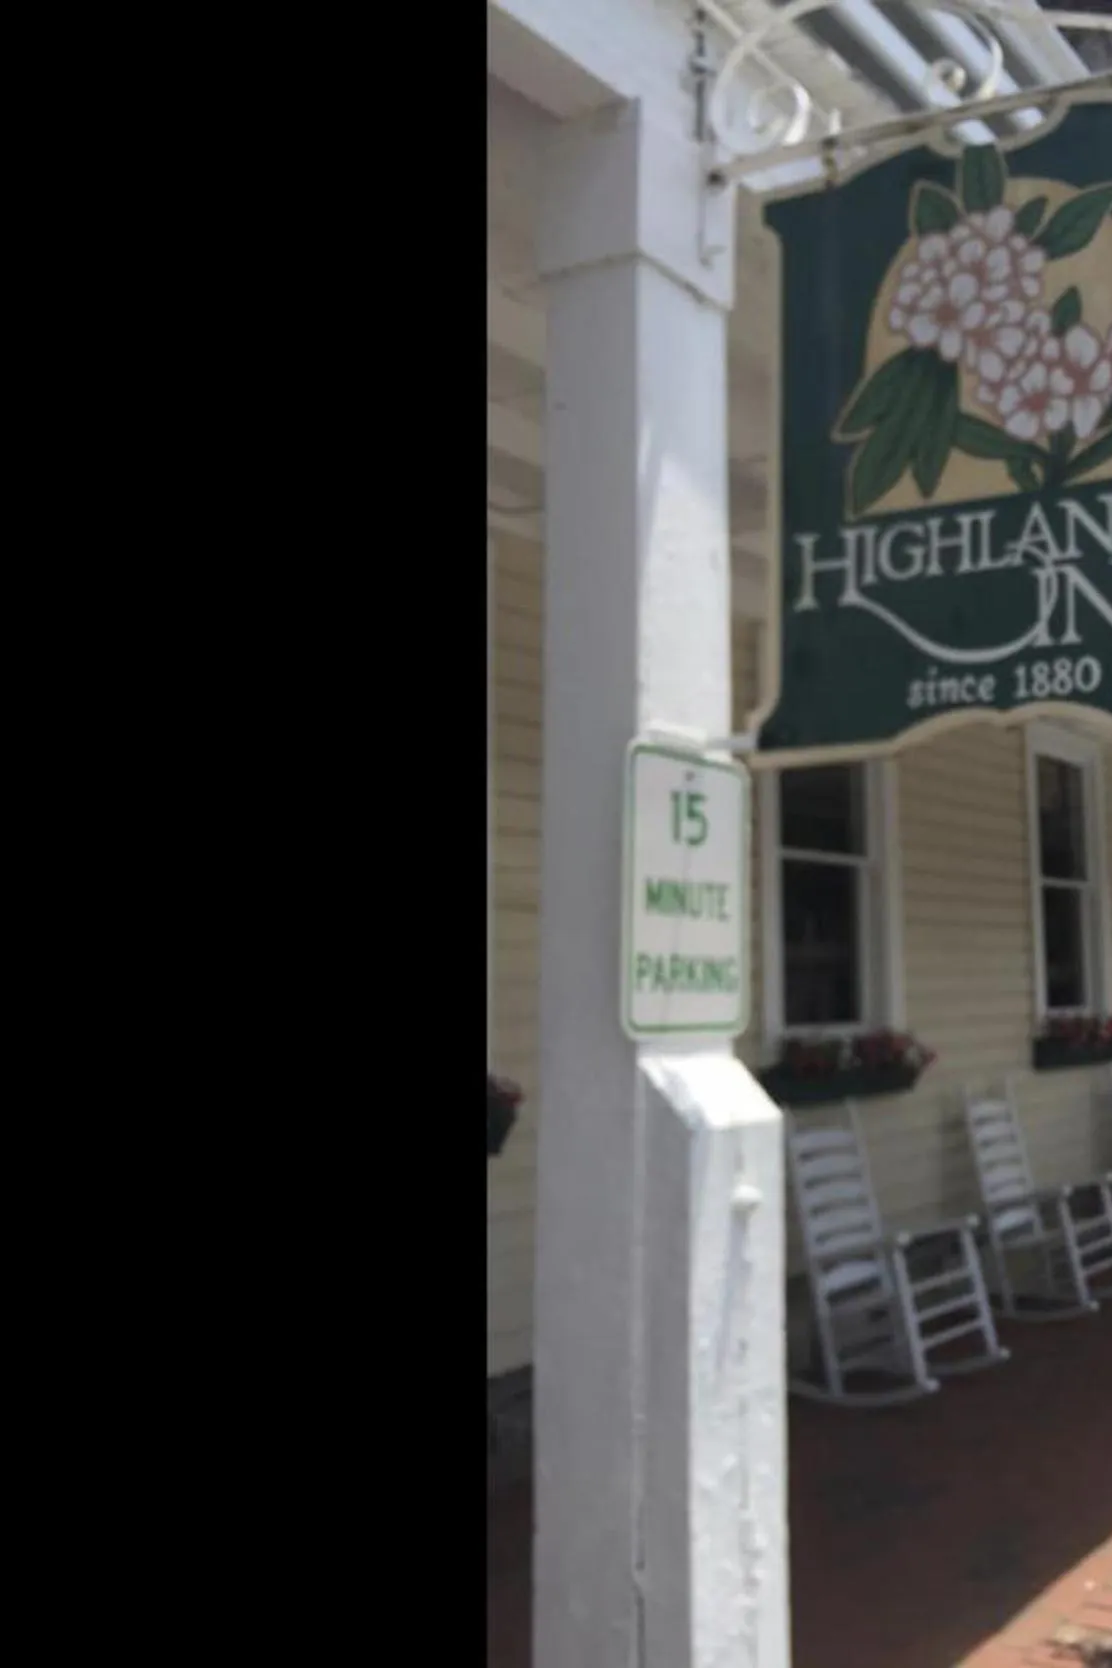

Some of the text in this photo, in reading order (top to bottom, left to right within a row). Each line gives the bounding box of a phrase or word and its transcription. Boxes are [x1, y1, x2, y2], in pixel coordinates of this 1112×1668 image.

[905, 655, 1103, 709] since 1880
[669, 788, 709, 848] 15
[645, 875, 733, 922] MINUTE
[634, 951, 739, 994] PARKING
